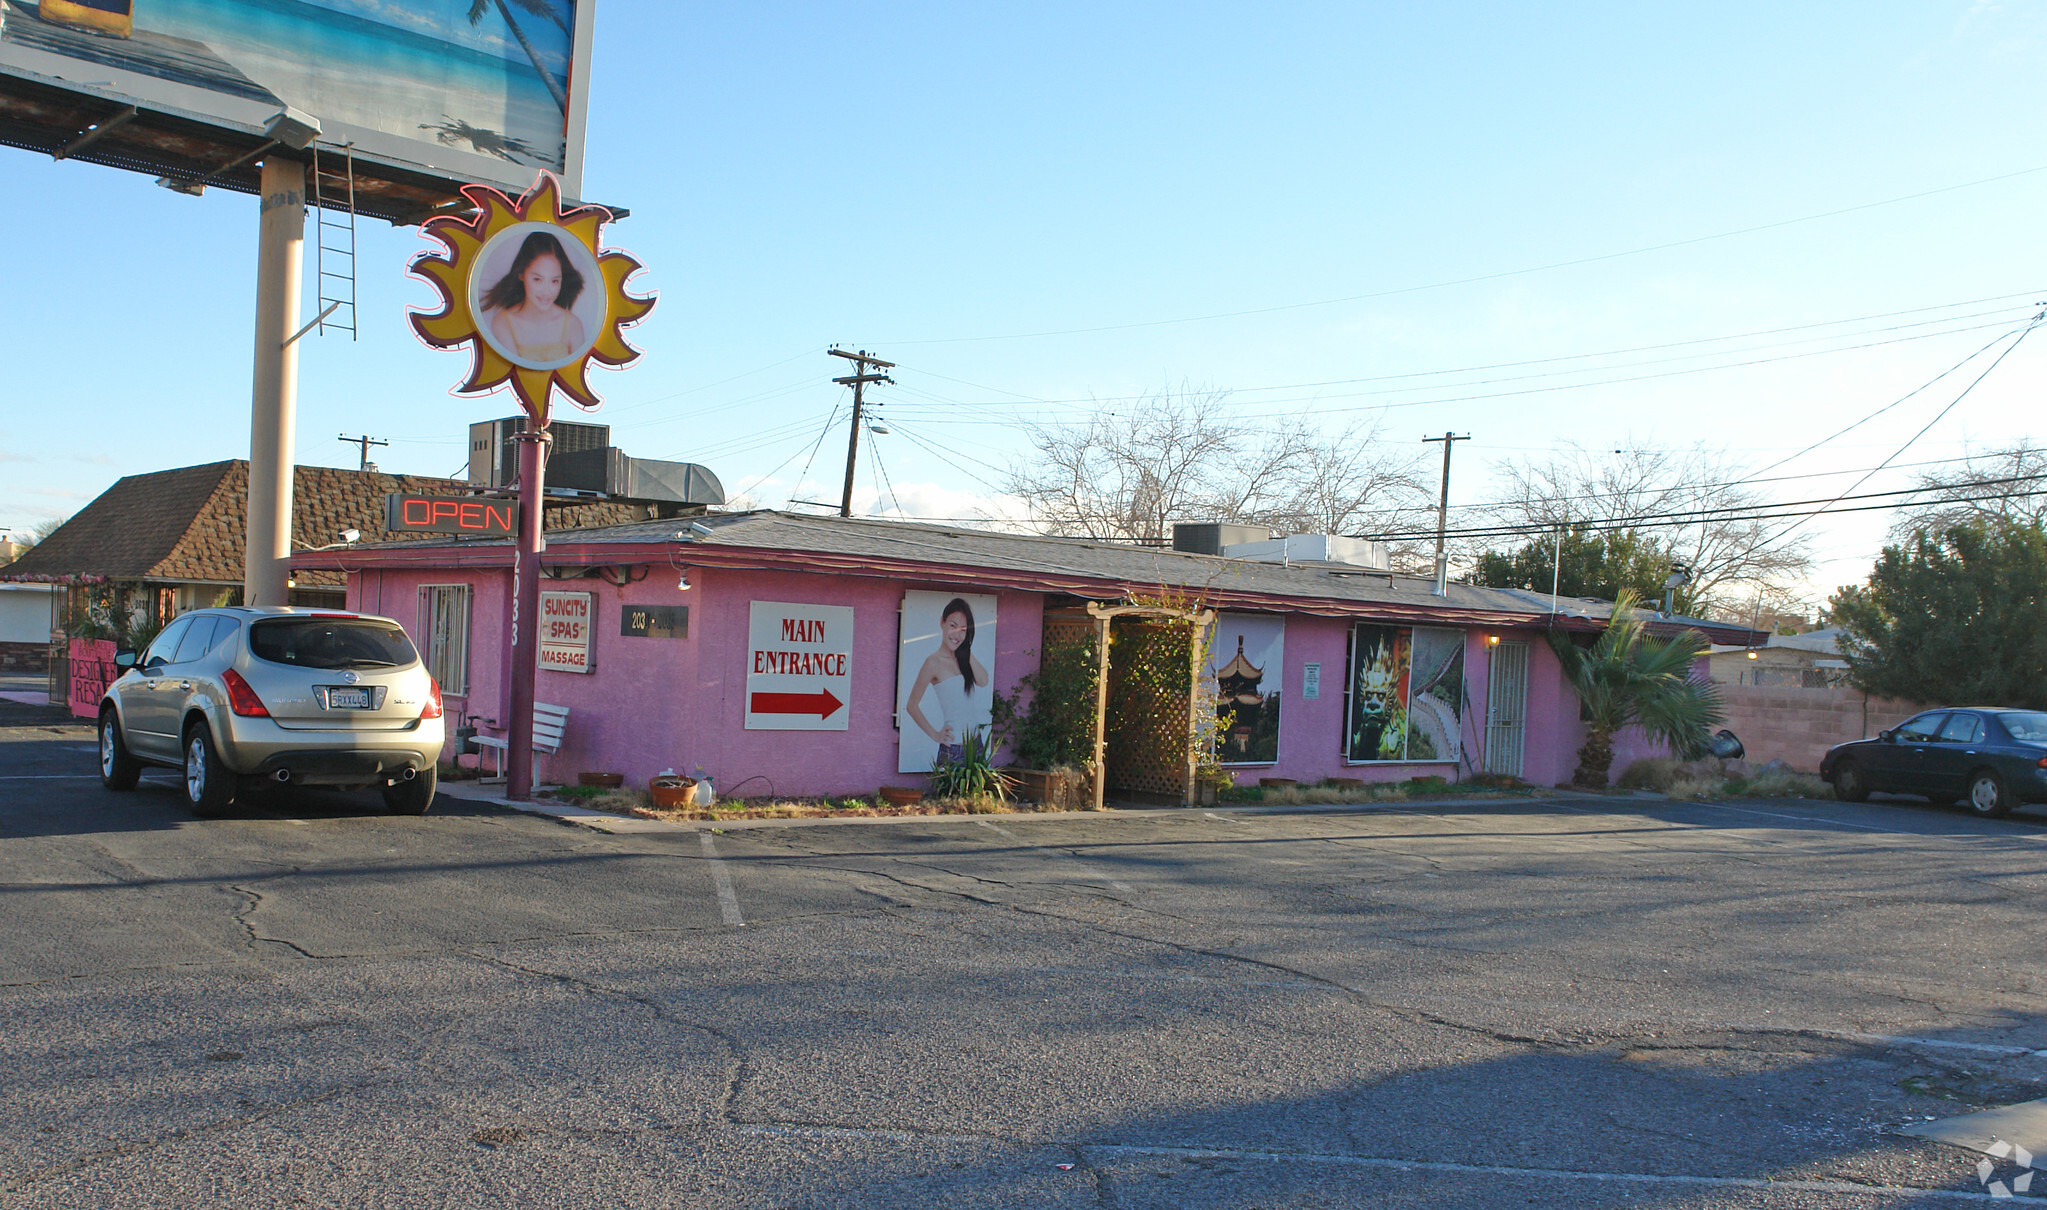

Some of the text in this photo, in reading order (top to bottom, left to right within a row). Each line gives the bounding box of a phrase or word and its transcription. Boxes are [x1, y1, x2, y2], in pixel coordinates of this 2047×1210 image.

[404, 500, 511, 531] OPEN
[512, 550, 520, 646] 2033
[545, 598, 587, 617] SUNCITY
[551, 621, 579, 639] SPAS
[781, 618, 826, 643] MAIN
[542, 650, 585, 666] MASSAGE
[753, 650, 847, 676] ENTRANCE
